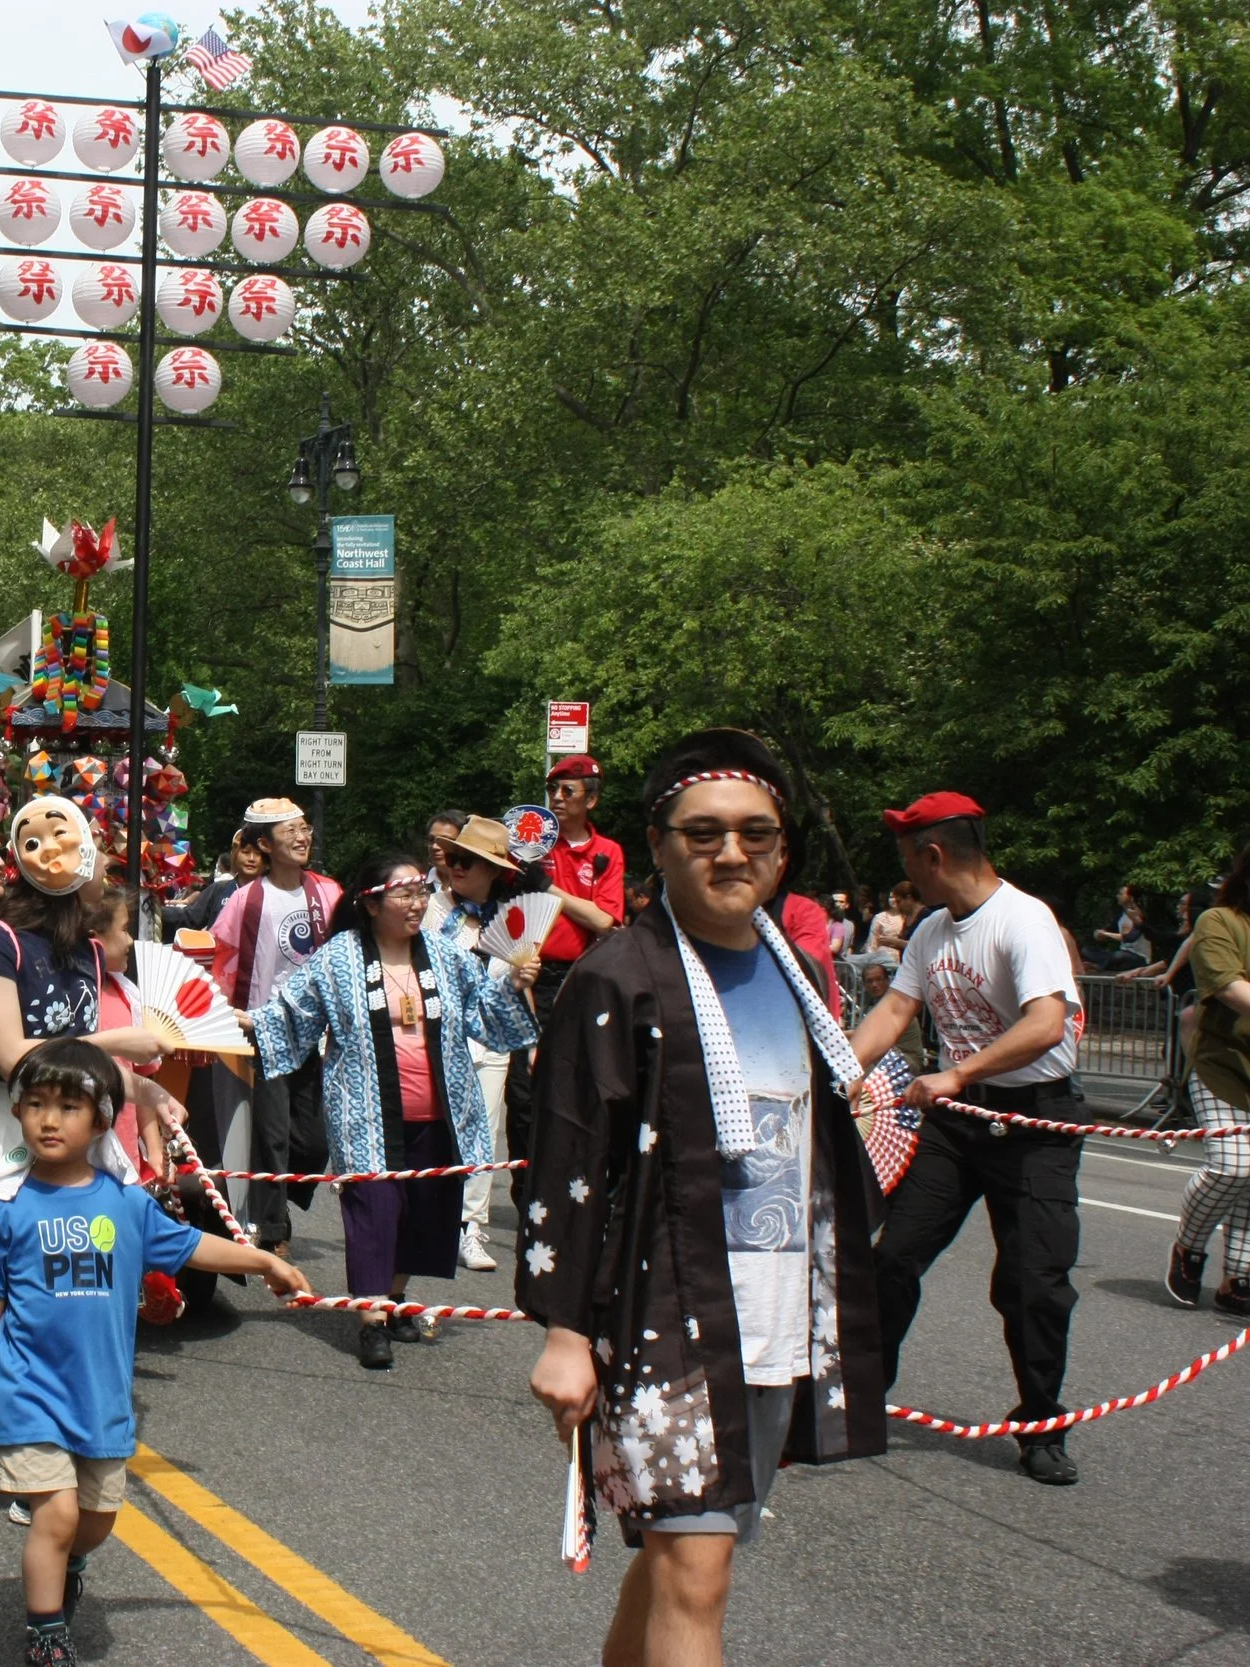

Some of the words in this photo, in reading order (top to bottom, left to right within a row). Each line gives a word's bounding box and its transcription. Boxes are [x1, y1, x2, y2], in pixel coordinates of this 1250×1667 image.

[18, 99, 56, 140] 祭
[94, 106, 133, 148] 祭
[181, 112, 221, 157] 祭
[264, 120, 297, 160] 祭
[323, 127, 359, 171] 祭
[388, 133, 425, 174] 祭
[6, 179, 47, 220] 祭
[84, 184, 123, 227] 祭
[176, 192, 214, 232] 祭
[243, 199, 281, 242] 祭
[321, 204, 361, 248] 祭
[18, 260, 56, 305] 祭
[97, 264, 134, 307] 祭
[177, 269, 217, 316] 祭
[237, 276, 277, 322] 祭
[84, 342, 123, 384] 祭
[168, 346, 209, 389] 祭
[336, 549, 389, 559] Northwest
[336, 559, 364, 569] Coast
[365, 558, 385, 568] Hall
[300, 738, 321, 746] RIGHT
[324, 738, 343, 746] TURN
[311, 749, 332, 757] FROM
[300, 760, 321, 768] RIGHT
[324, 760, 342, 768] TURN
[303, 771, 318, 779] BAY
[320, 771, 338, 780] ONLY
[516, 811, 544, 843] 祭
[926, 957, 985, 989] GUARDIAN
